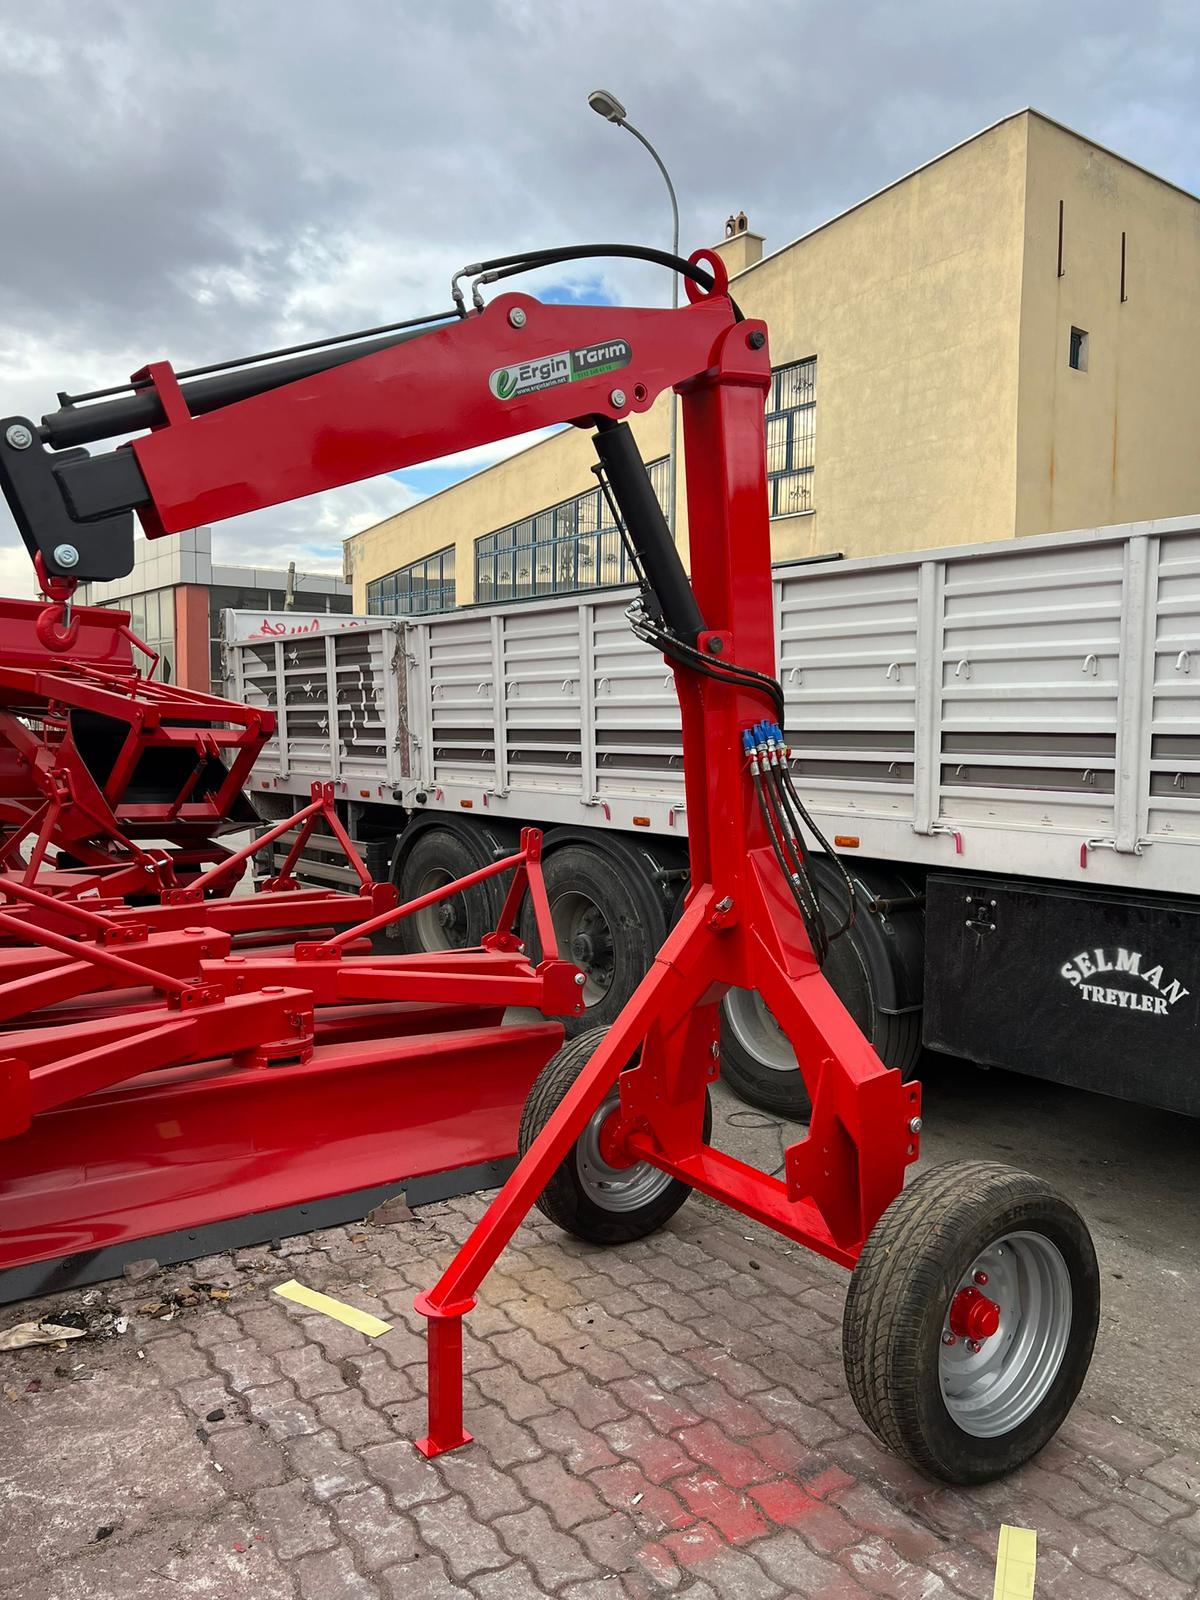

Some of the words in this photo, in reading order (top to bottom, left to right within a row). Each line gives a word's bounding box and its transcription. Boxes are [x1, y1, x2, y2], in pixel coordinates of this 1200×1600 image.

[519, 359, 568, 382] Ergin
[575, 343, 626, 366] Tarım
[1061, 948, 1190, 1005] SELMAN
[1080, 983, 1169, 1015] TREYLER
